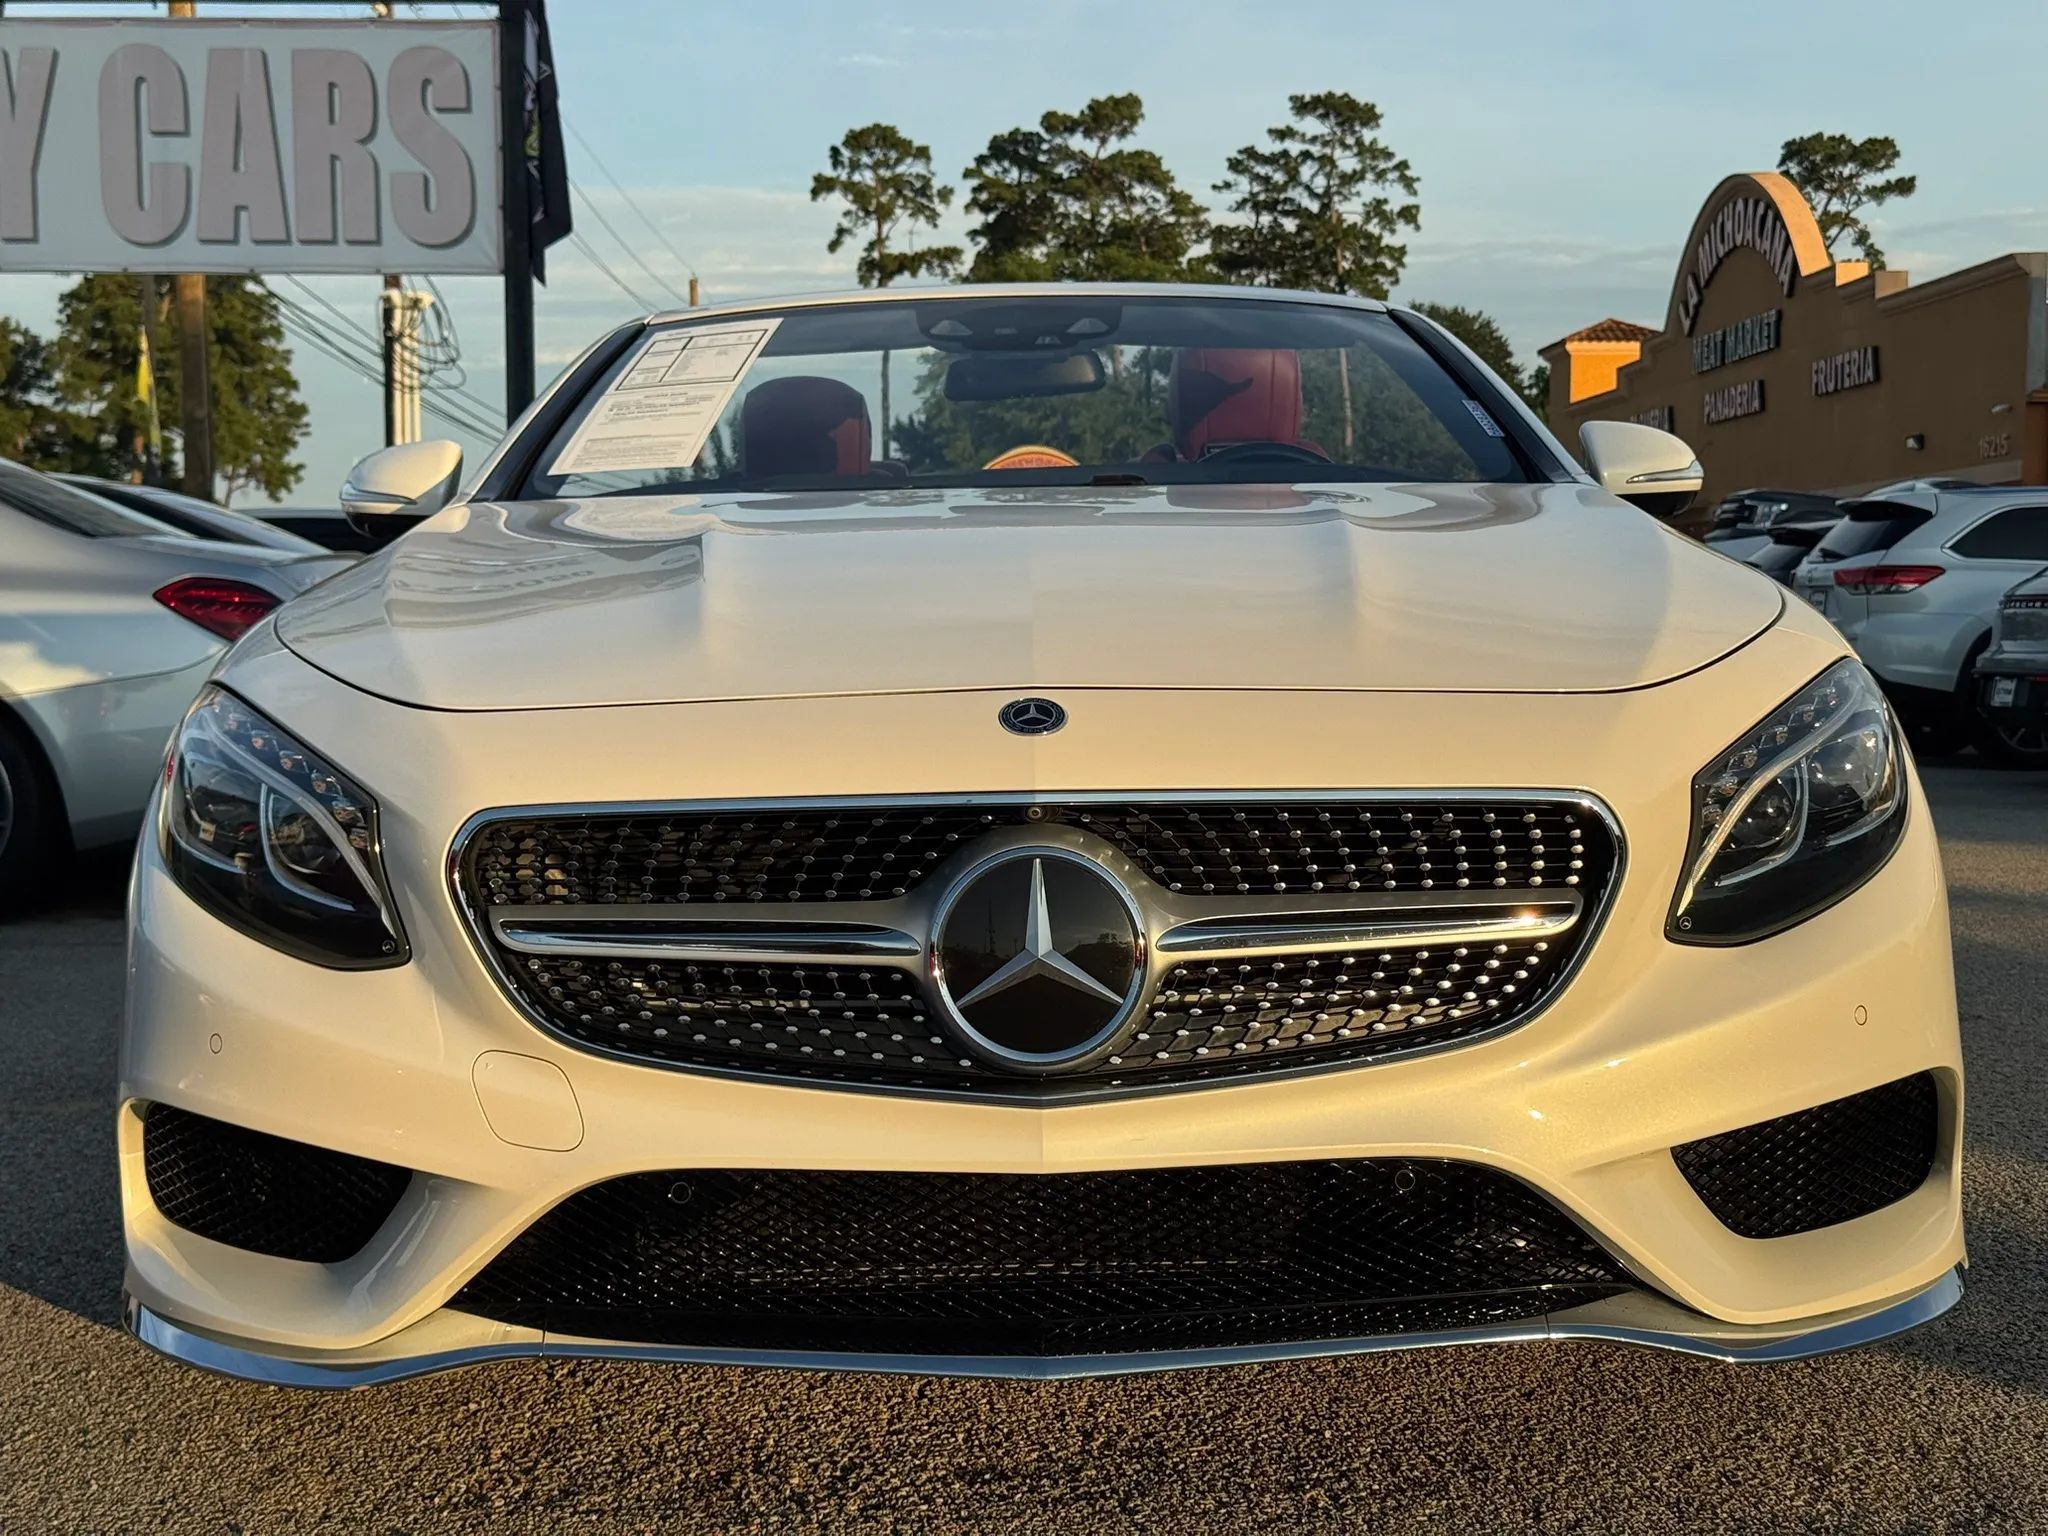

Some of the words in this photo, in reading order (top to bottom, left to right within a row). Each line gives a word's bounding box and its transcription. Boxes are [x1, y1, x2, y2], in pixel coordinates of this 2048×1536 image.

[99, 43, 476, 249] CARS
[1678, 273, 1700, 336] LA
[1698, 198, 1795, 298] MICHOACANA
[1693, 329, 1724, 374] MEAT
[1725, 308, 1778, 364] MARKET
[1811, 346, 1876, 396] FRUTERIA
[1703, 380, 1762, 425] PANADERIA
